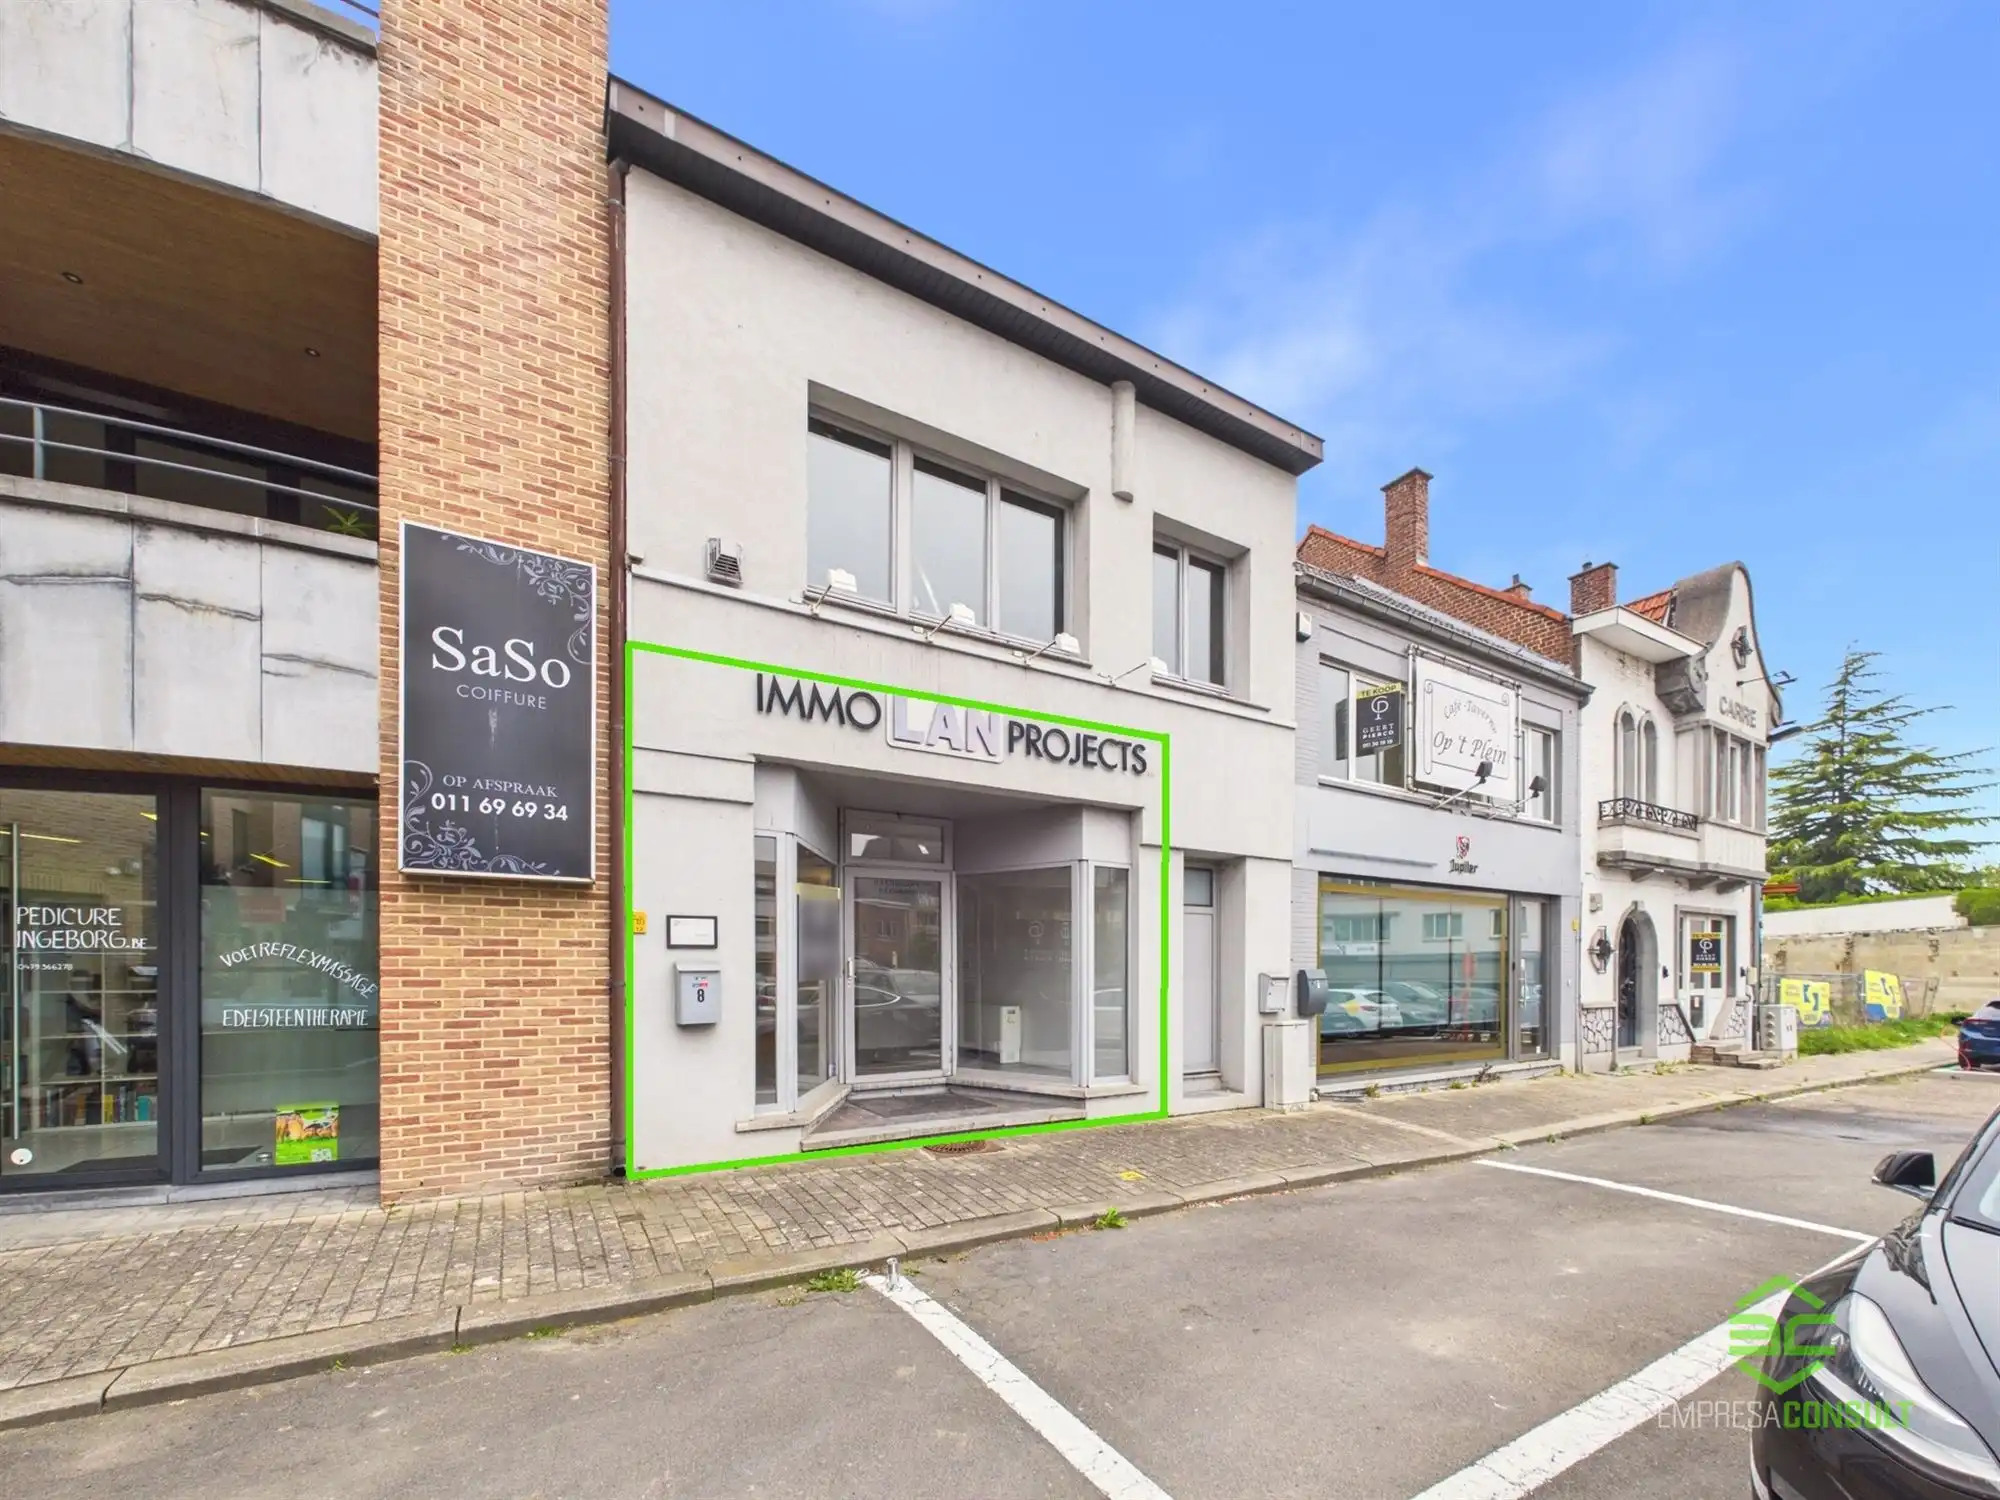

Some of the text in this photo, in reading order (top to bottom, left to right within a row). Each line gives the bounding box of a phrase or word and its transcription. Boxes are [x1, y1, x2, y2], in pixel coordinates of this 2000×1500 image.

[431, 626, 571, 689] SaSo
[456, 684, 547, 710] COIFFURE
[1373, 685, 1397, 694] KOOP
[757, 673, 1148, 775] IMMO LAN PROJECTS
[1362, 723, 1394, 734] GEERT
[1433, 731, 1453, 755] Op
[1470, 739, 1507, 764] Plein
[443, 774, 558, 798] OP AFSPRAAK
[431, 793, 568, 821] 011 69 69 34
[16, 907, 122, 926] PEDICURE
[220, 942, 378, 999] VOETREFLEXMASSAGE
[697, 988, 705, 1003] 8
[223, 1008, 369, 1027] EDELSTEENTHERAPIE
